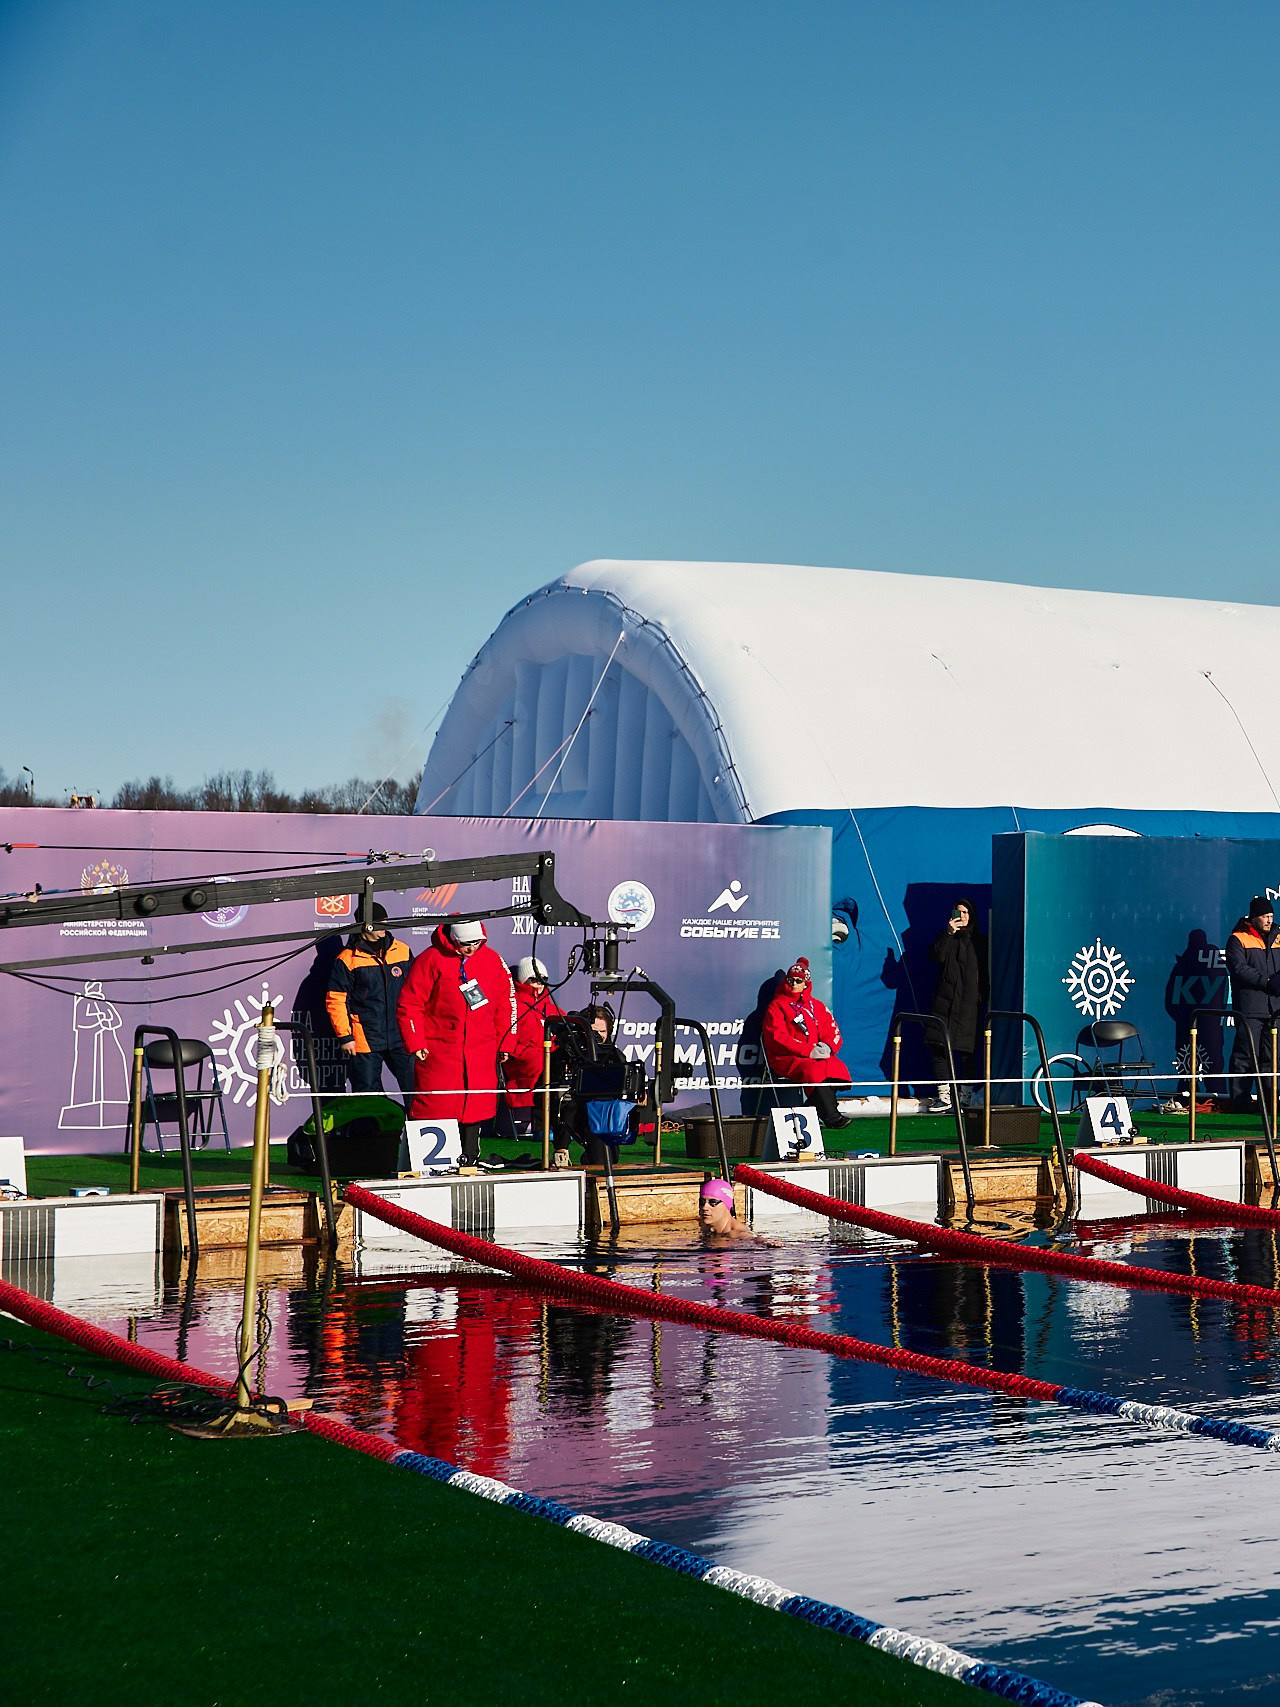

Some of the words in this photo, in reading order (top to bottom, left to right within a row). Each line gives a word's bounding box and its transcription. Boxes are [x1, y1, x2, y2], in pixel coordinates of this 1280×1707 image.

[511, 875, 531, 893] НА
[682, 918, 712, 926] КАЖДОЕ
[733, 919, 780, 927] МЕРОПРИЯТИЕ
[60, 928, 107, 937] РОССИЙСКОЙ
[107, 929, 148, 937] ФЕДЕРАЦИИ
[680, 927, 758, 938] СОБЫТИЕ
[761, 927, 781, 939] 51
[1100, 1102, 1125, 1136] 4
[784, 1113, 812, 1150] 3
[419, 1126, 452, 1166] 2
